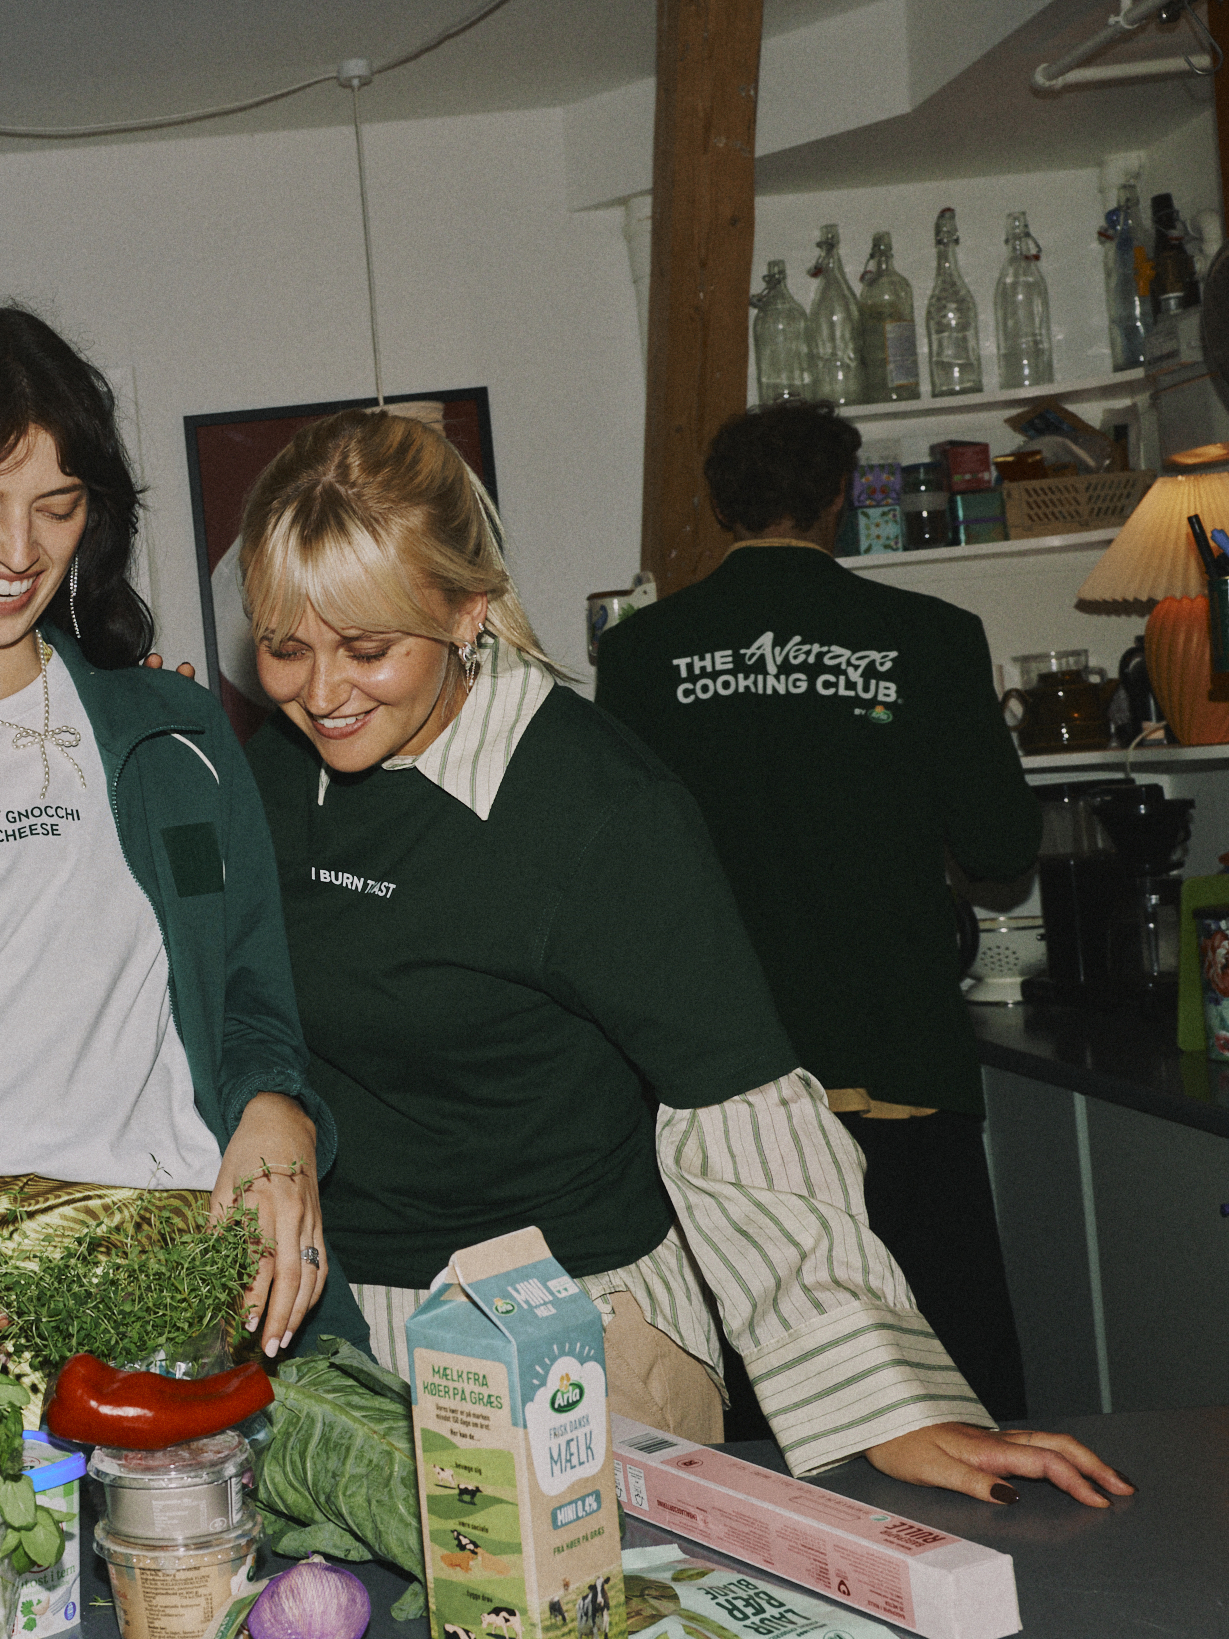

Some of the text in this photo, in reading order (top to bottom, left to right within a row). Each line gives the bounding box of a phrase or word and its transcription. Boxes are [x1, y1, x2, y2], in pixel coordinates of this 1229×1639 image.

[672, 631, 899, 682] THE Average
[676, 672, 898, 704] COOKING CLUB
[5, 805, 81, 824] GNOCCHI
[311, 866, 397, 899] I BURN TAST
[507, 1278, 554, 1310] MINI
[431, 1364, 490, 1389] MÆLK FRA
[422, 1380, 503, 1410] KØER PÅ GRÆS
[554, 1386, 581, 1409] Arla
[549, 1414, 591, 1440] FRISK DANSK
[549, 1430, 595, 1478] MÆLK
[556, 1493, 598, 1526] MINI 0,4%
[884, 1521, 947, 1544] RULLE
[553, 1545, 565, 1557] FRA
[56, 1564, 76, 1580] tern
[696, 1578, 760, 1601] BLADE
[715, 1590, 787, 1622] BÆR
[742, 1608, 812, 1636] LAUR
